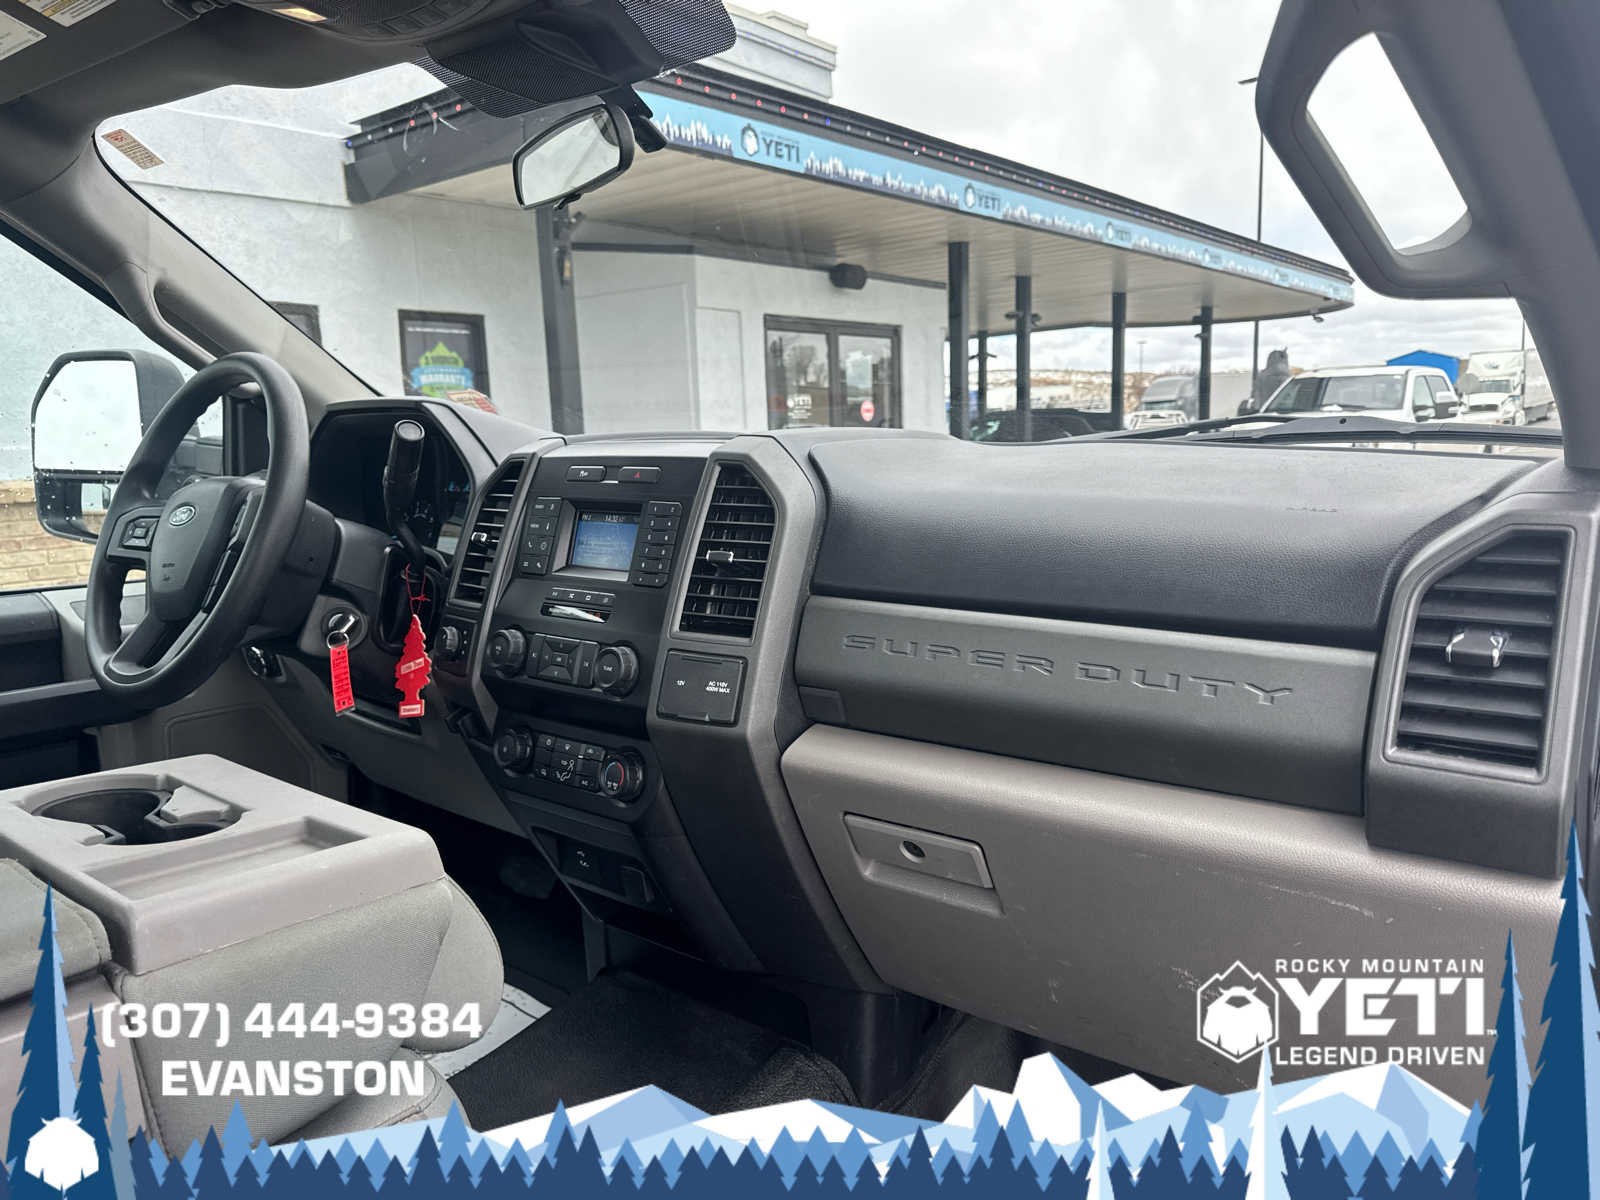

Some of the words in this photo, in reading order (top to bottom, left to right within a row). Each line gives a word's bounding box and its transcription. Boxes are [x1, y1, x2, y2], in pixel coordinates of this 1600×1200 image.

[761, 136, 800, 163] YETI
[977, 192, 1001, 213] YETI
[843, 634, 1055, 676] SUPER
[1073, 661, 1294, 706] DUTY
